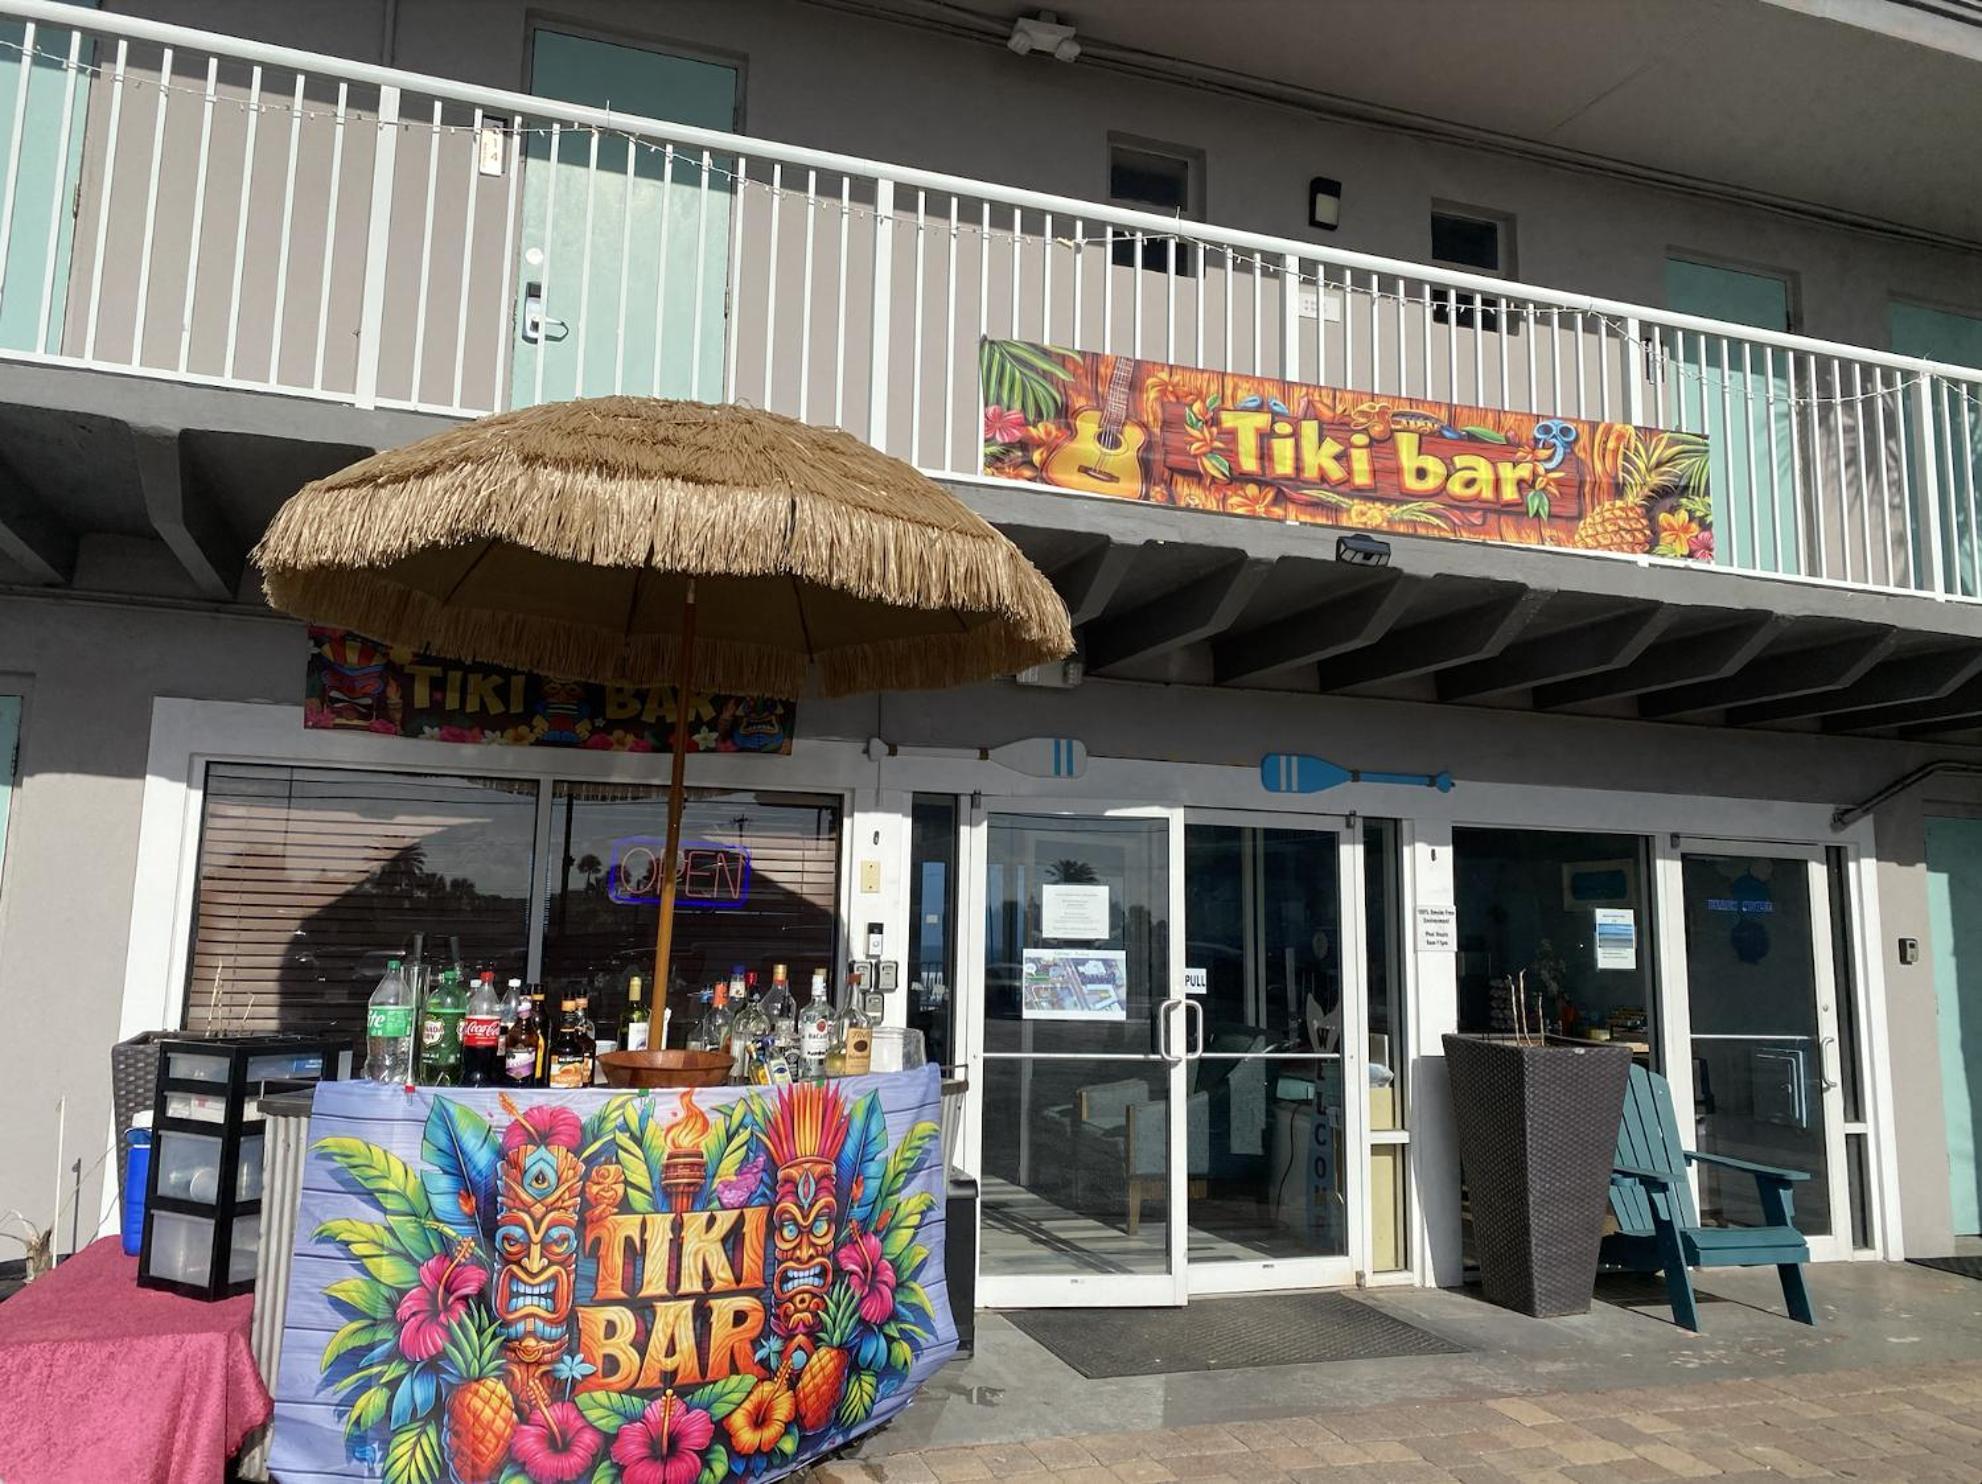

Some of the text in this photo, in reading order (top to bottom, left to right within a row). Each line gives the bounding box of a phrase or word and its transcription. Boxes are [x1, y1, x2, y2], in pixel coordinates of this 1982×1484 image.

[1218, 410, 1535, 504] Tiki bar
[403, 664, 526, 716] TIKI
[620, 846, 745, 900] OPEN
[1184, 974, 1206, 987] PULL
[585, 1206, 770, 1301] TIKI
[574, 1295, 769, 1396] BAR
